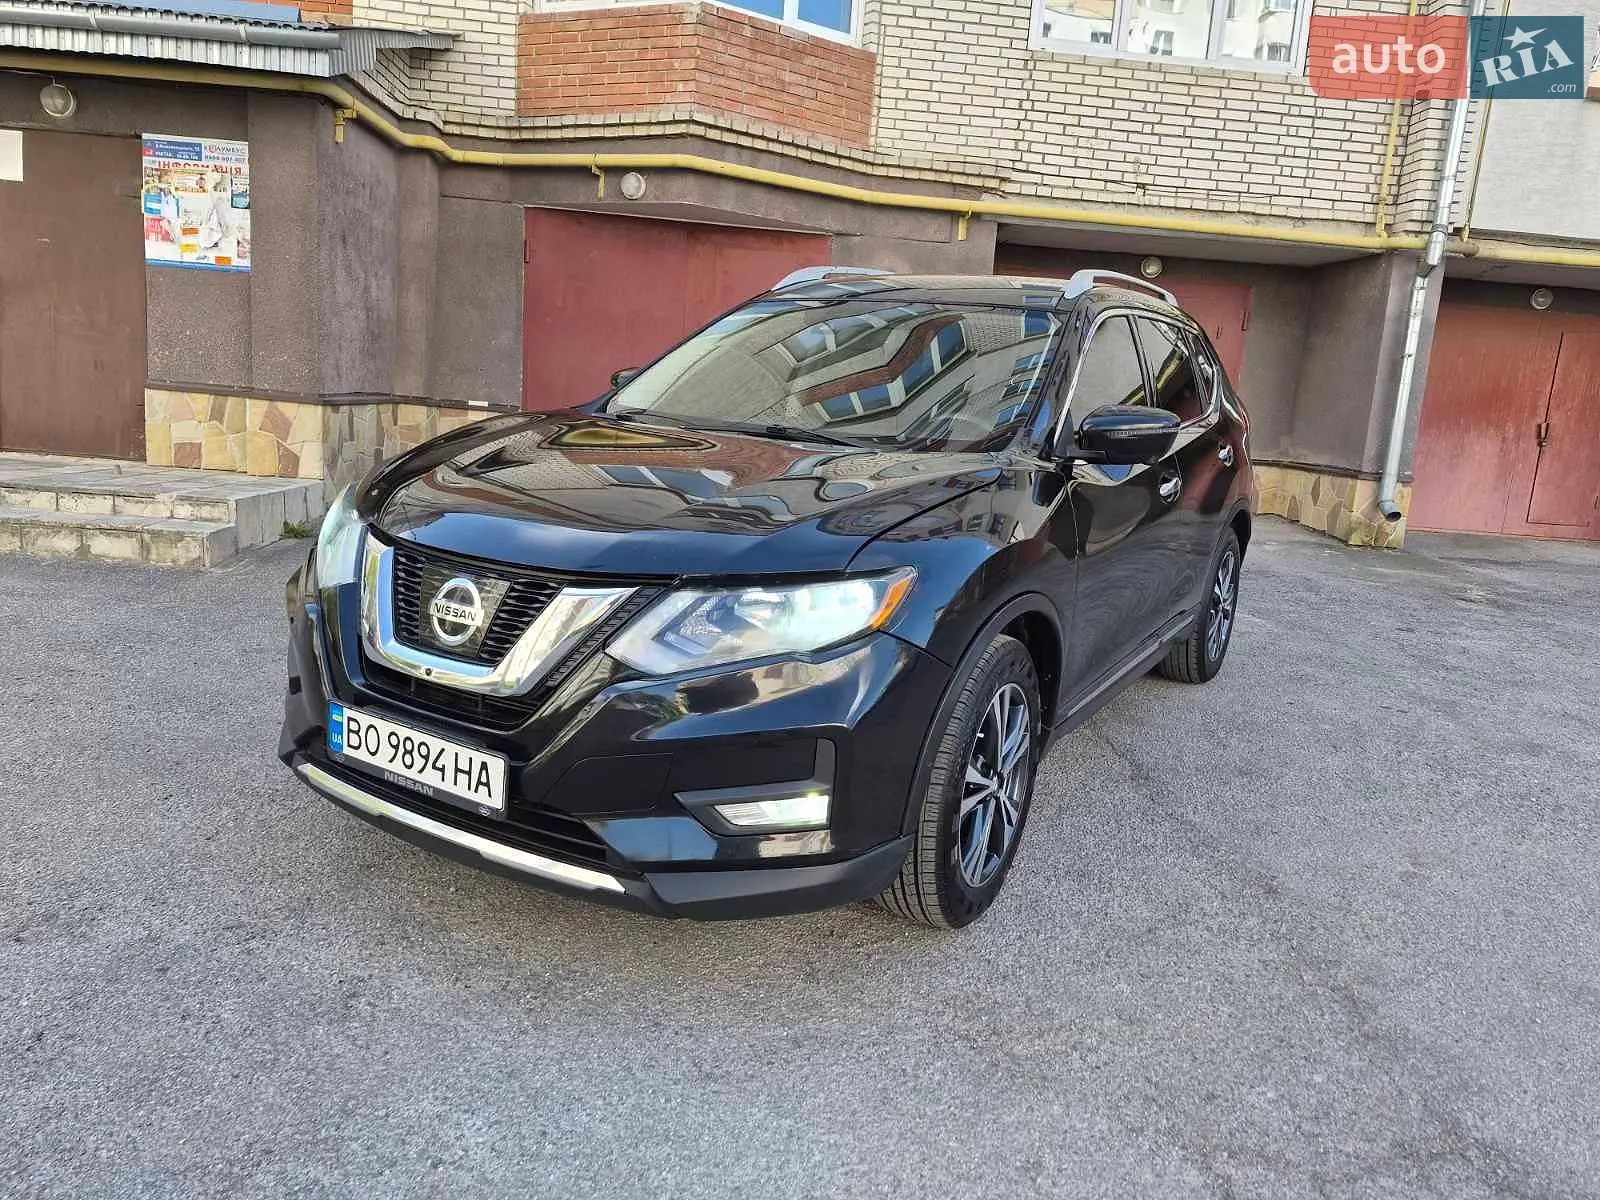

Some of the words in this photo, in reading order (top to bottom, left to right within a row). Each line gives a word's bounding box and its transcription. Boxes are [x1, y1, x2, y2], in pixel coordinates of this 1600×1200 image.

[434, 602, 477, 622] NISSAN
[331, 732, 343, 745] UA
[346, 715, 381, 757] BO
[387, 731, 446, 782] 9894
[453, 751, 492, 798] HA
[383, 769, 434, 797] NISSAN
